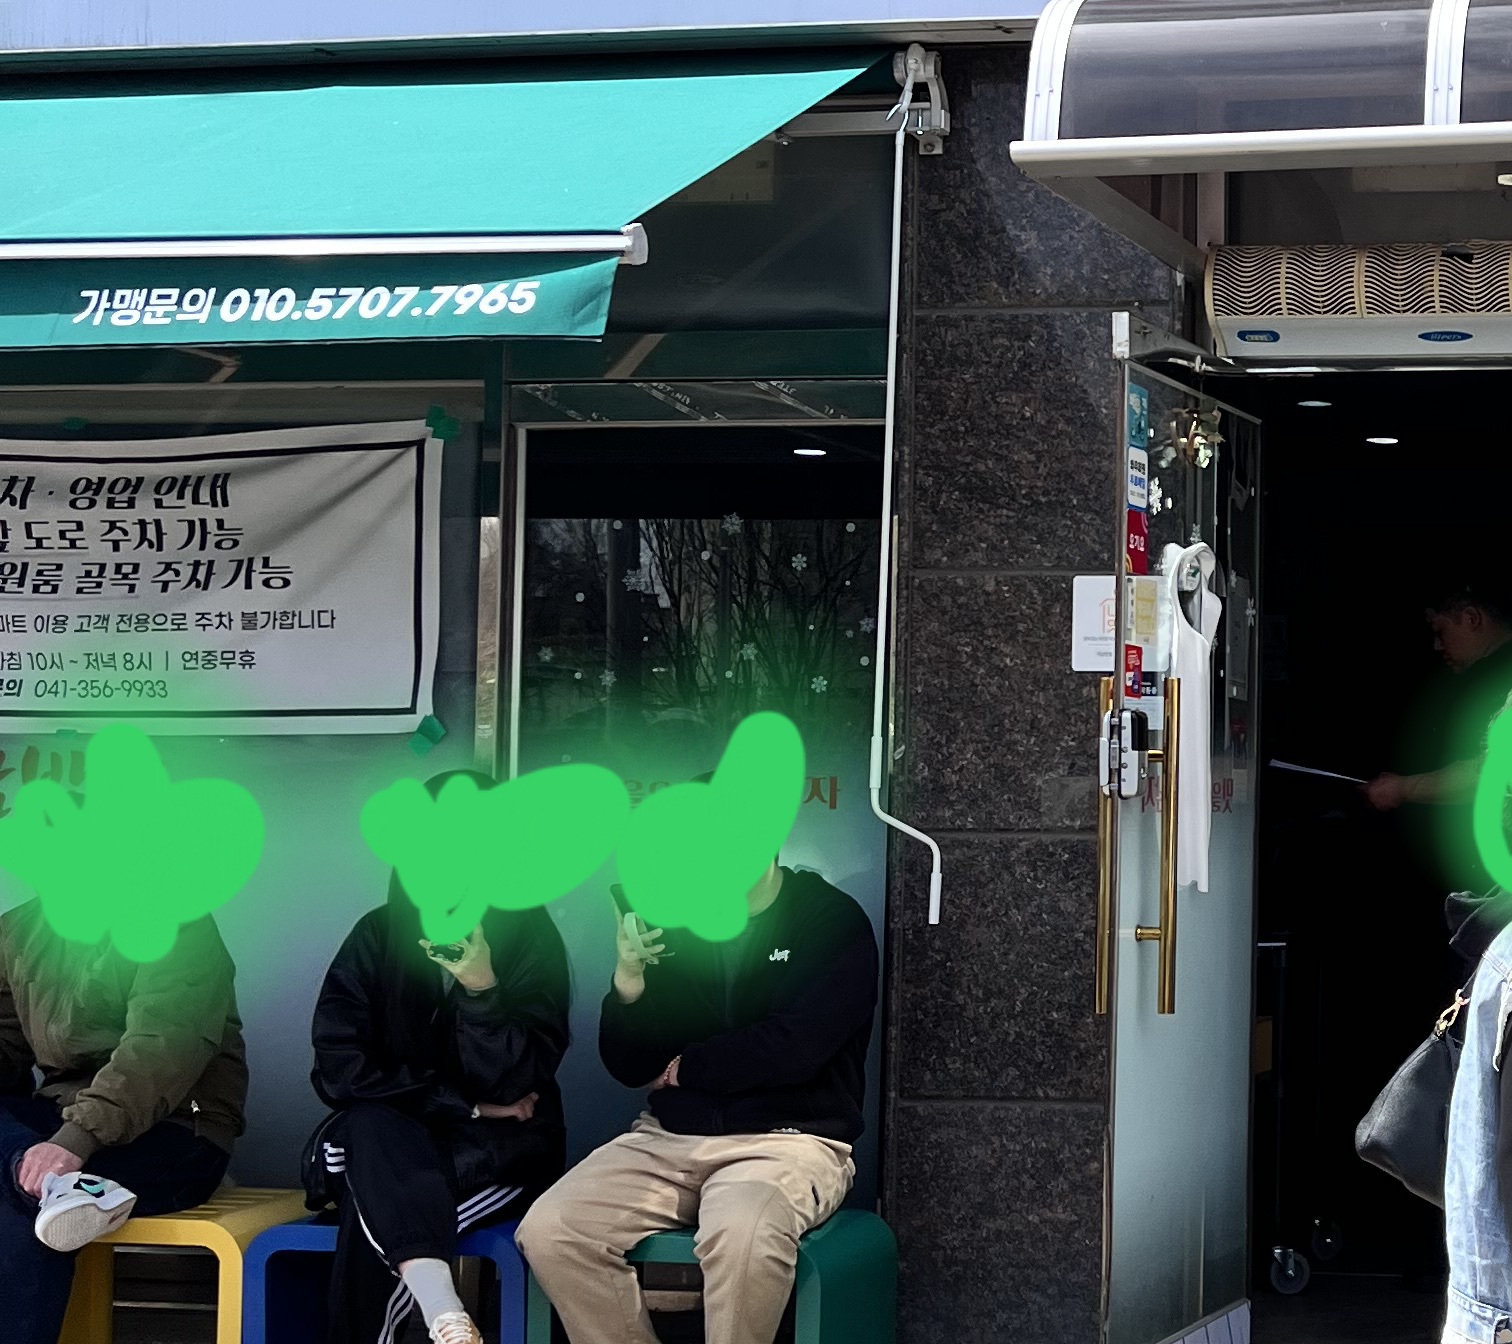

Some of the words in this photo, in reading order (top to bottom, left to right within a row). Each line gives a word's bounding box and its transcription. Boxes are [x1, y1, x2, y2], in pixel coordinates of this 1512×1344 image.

[72, 287, 214, 327] 가맹문의
[219, 281, 540, 324] 010.5707.7965
[68, 475, 145, 510] 영업
[153, 472, 231, 509] 안내
[24, 519, 89, 551] 도로
[100, 517, 168, 552] 주차
[176, 517, 244, 551] 가능
[0, 561, 64, 595] 원룸
[75, 562, 140, 595] 골목
[150, 559, 217, 593] 주차
[221, 556, 294, 590] 가능
[34, 614, 69, 634] 이용
[74, 613, 110, 634] 고객
[116, 612, 189, 633] 전용으로
[194, 611, 235, 632] 주차
[240, 609, 337, 631] 불가합니다
[27, 651, 64, 672] 10시
[83, 651, 118, 672] 저녁
[123, 651, 152, 672] 8시
[181, 649, 257, 671] 연중무휴
[34, 678, 169, 699] 041-356-9933
